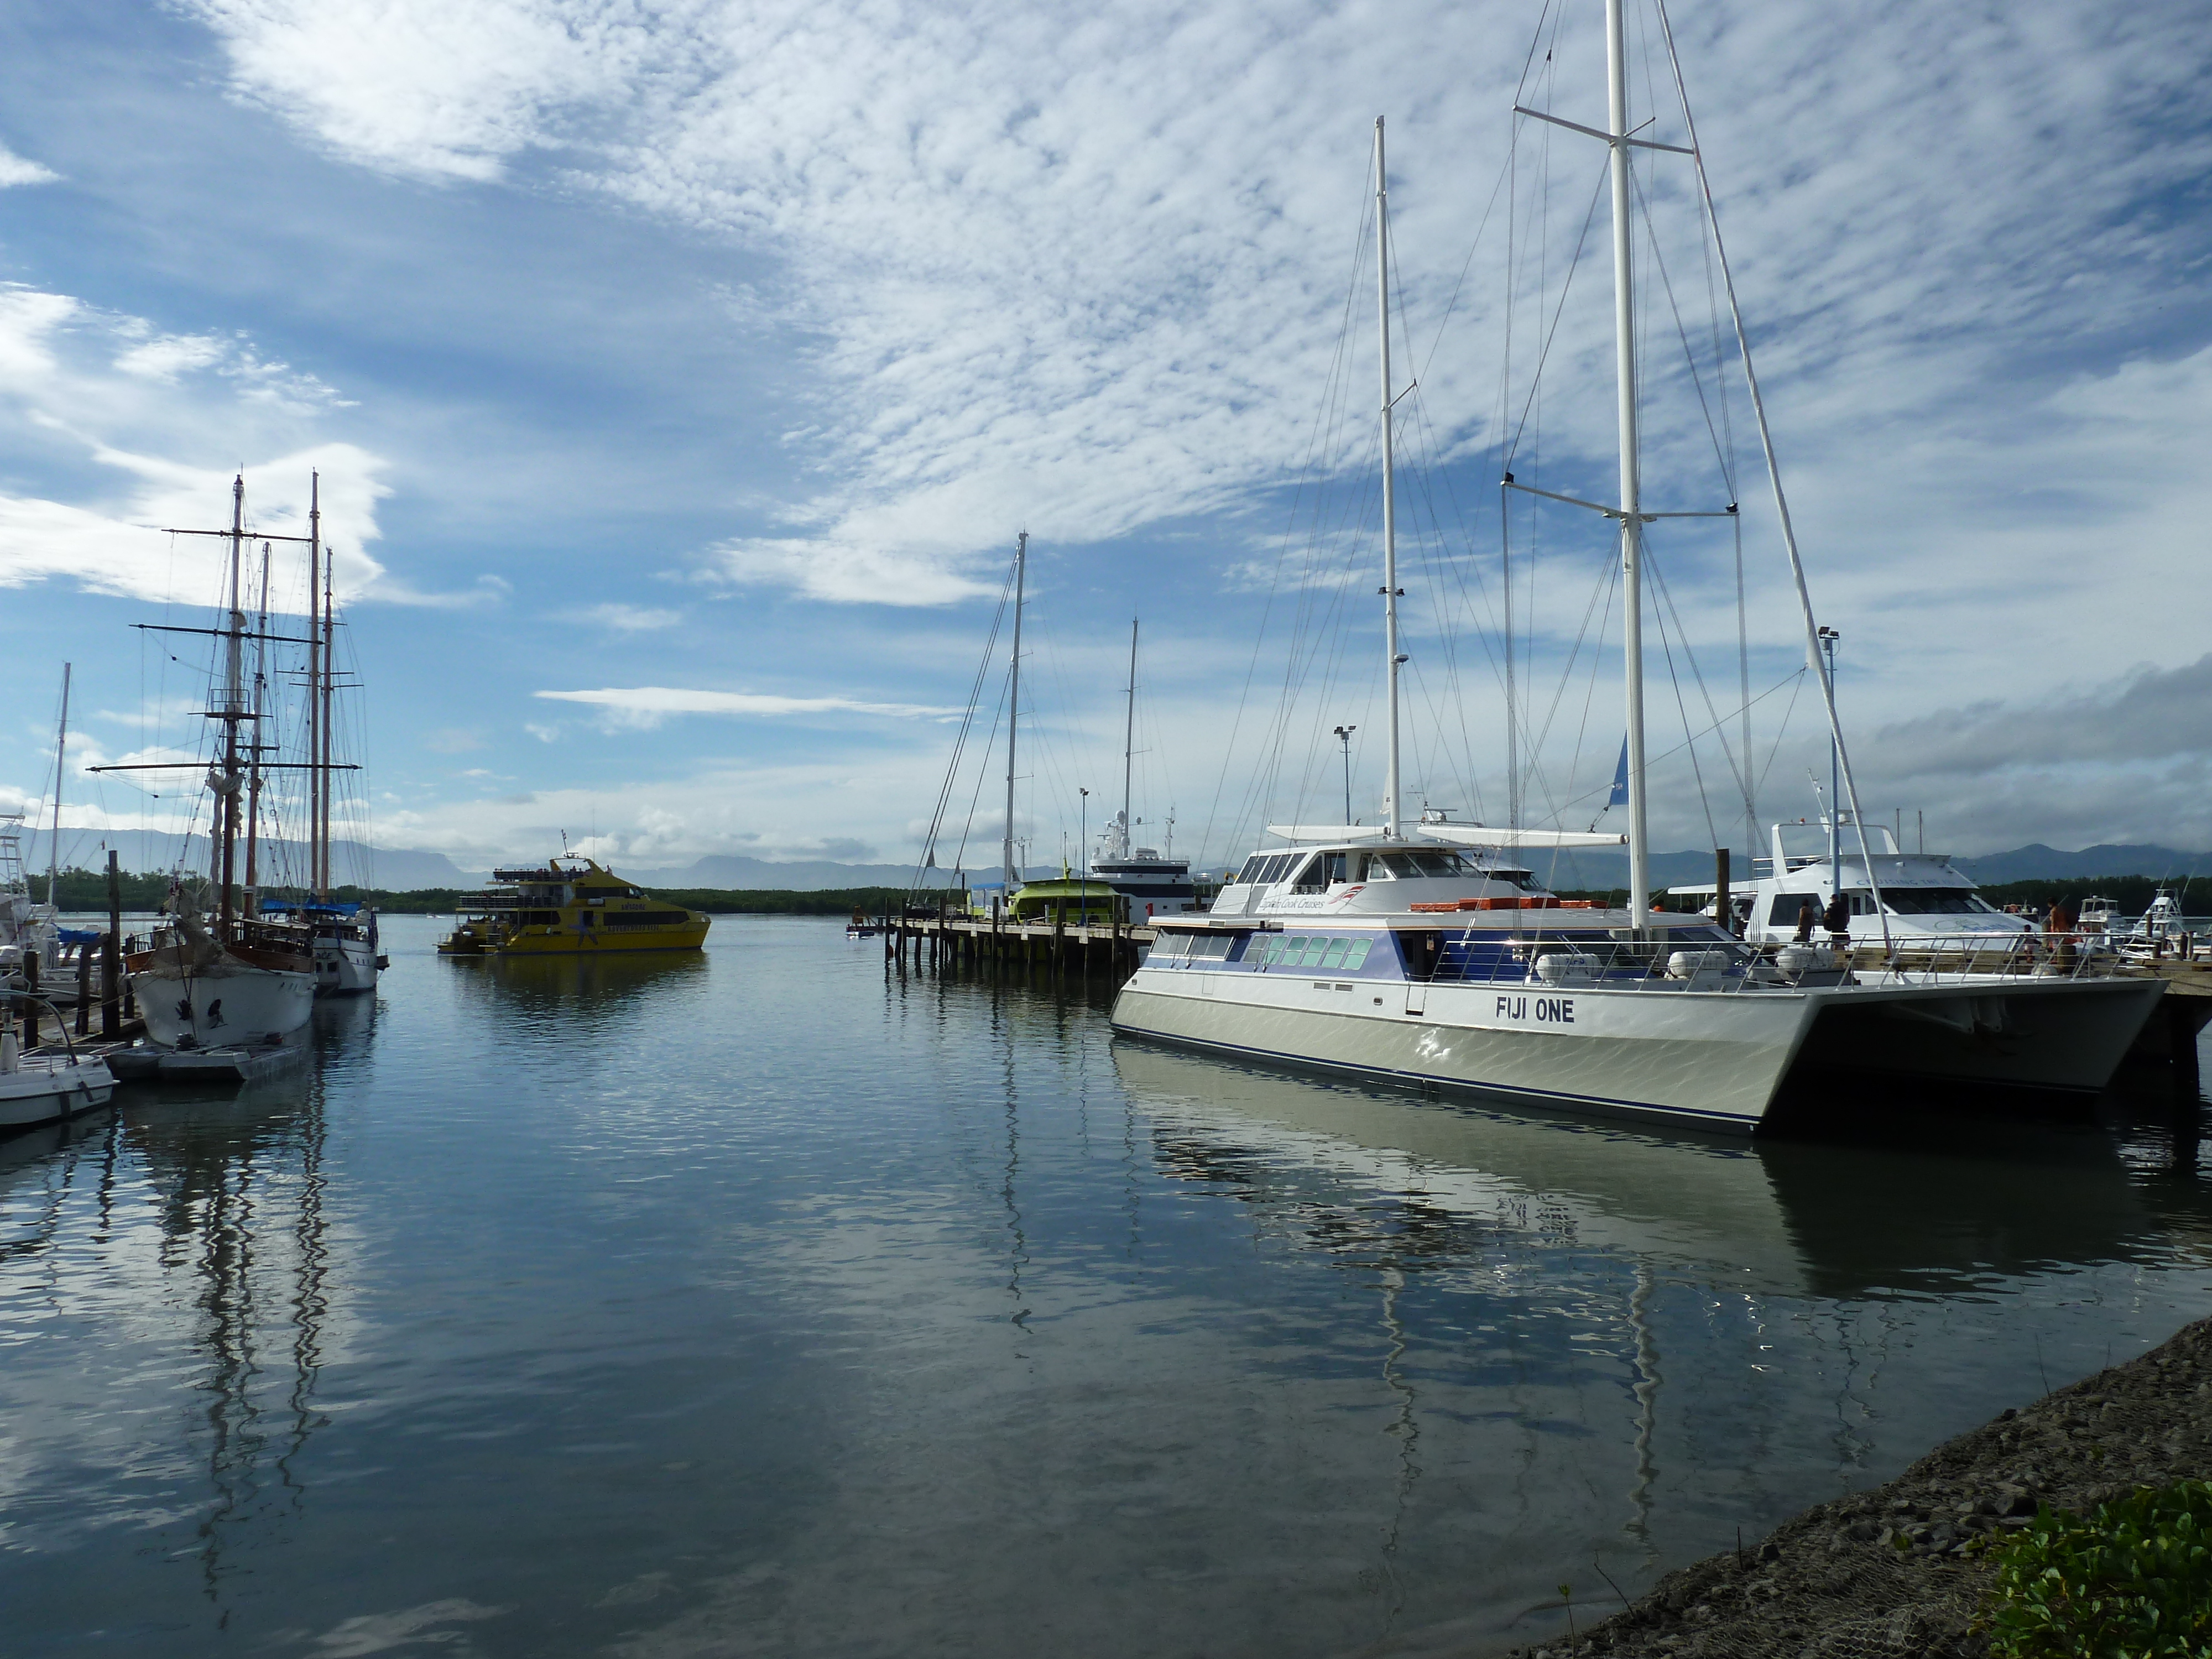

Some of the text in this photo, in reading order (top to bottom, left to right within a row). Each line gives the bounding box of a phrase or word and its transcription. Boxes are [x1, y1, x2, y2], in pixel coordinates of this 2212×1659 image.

[1281, 898, 1298, 908] Cook
[1298, 898, 1325, 909] Cruises
[1496, 997, 1574, 1023] FIJI ONE
